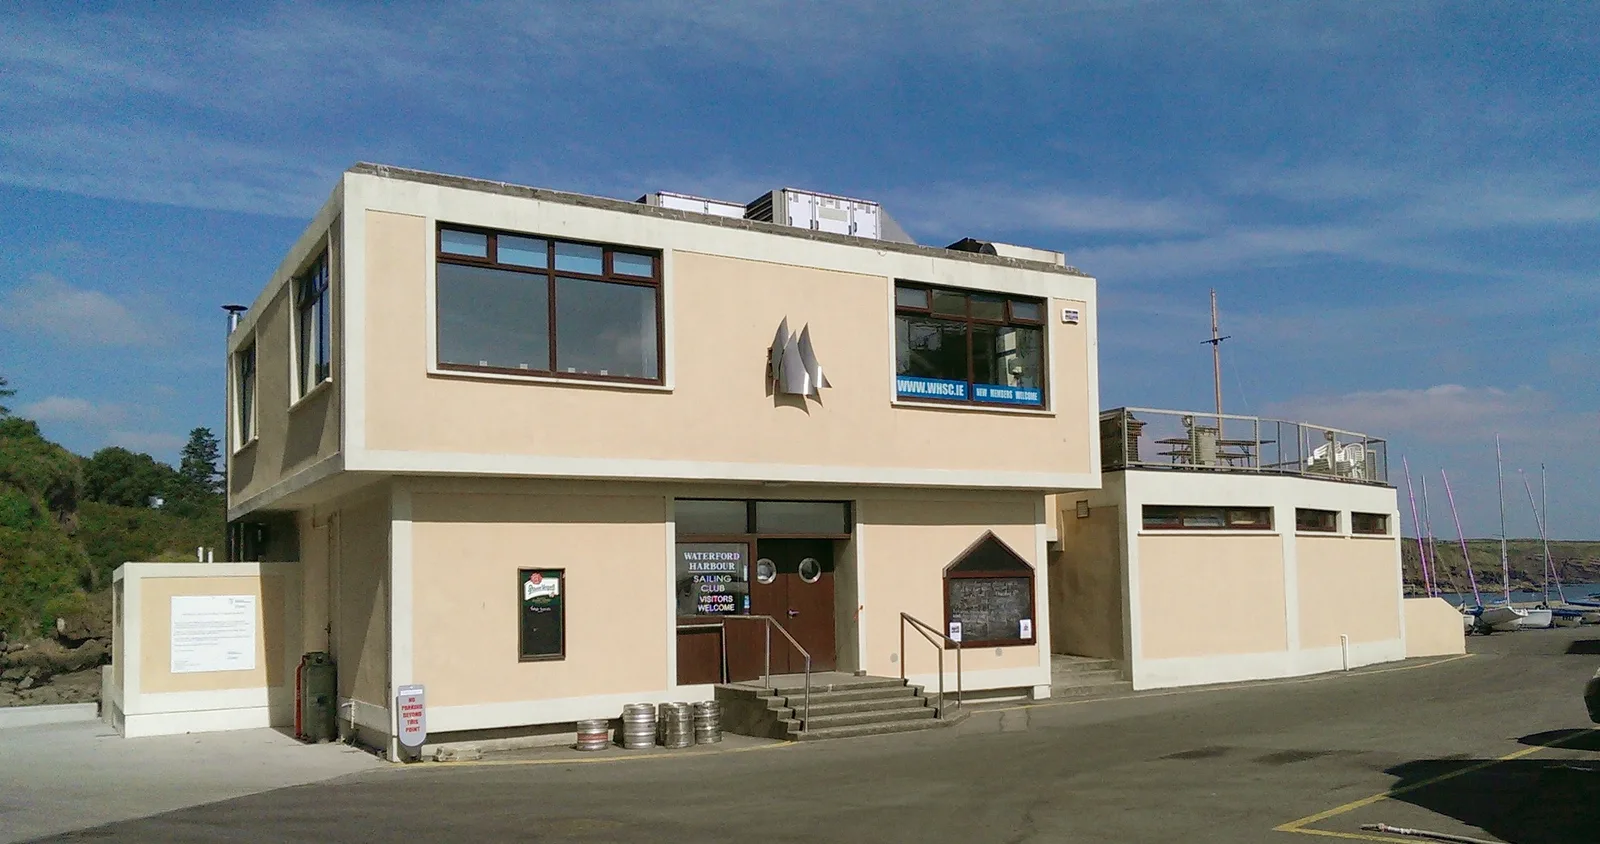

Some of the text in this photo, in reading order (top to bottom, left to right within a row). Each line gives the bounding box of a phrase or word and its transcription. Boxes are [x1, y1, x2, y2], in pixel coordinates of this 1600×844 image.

[897, 379, 964, 397] WWW.WHSC.IE
[976, 387, 1038, 401] NEW MEMBERS WELCOME
[684, 552, 740, 560] WATERFORD
[689, 562, 735, 570] HARBOUR
[693, 575, 732, 583] SAILING
[700, 584, 725, 592] CLUB
[699, 595, 733, 603] VISITORS
[698, 604, 735, 612] WELCOME
